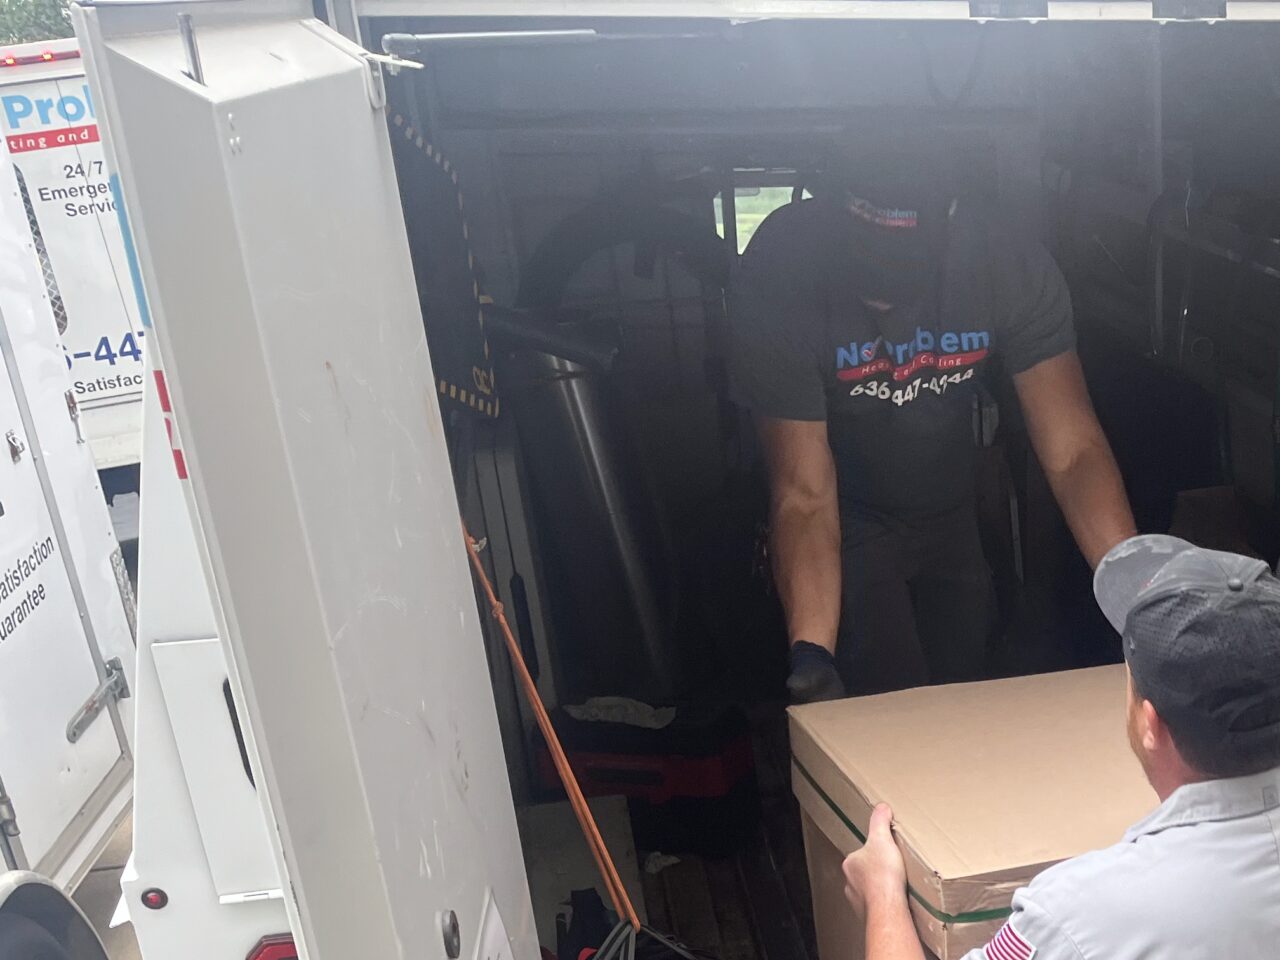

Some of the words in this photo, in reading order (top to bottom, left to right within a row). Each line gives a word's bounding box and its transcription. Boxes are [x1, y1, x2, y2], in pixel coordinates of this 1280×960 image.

[57, 129, 89, 143] and
[63, 160, 103, 179] 24/7
[63, 331, 144, 370] -44
[884, 326, 989, 364] rbem
[74, 374, 143, 393] Satisfac
[850, 380, 891, 400] 636
[0, 536, 54, 604] atisfaction
[0, 583, 46, 642] uarantee
